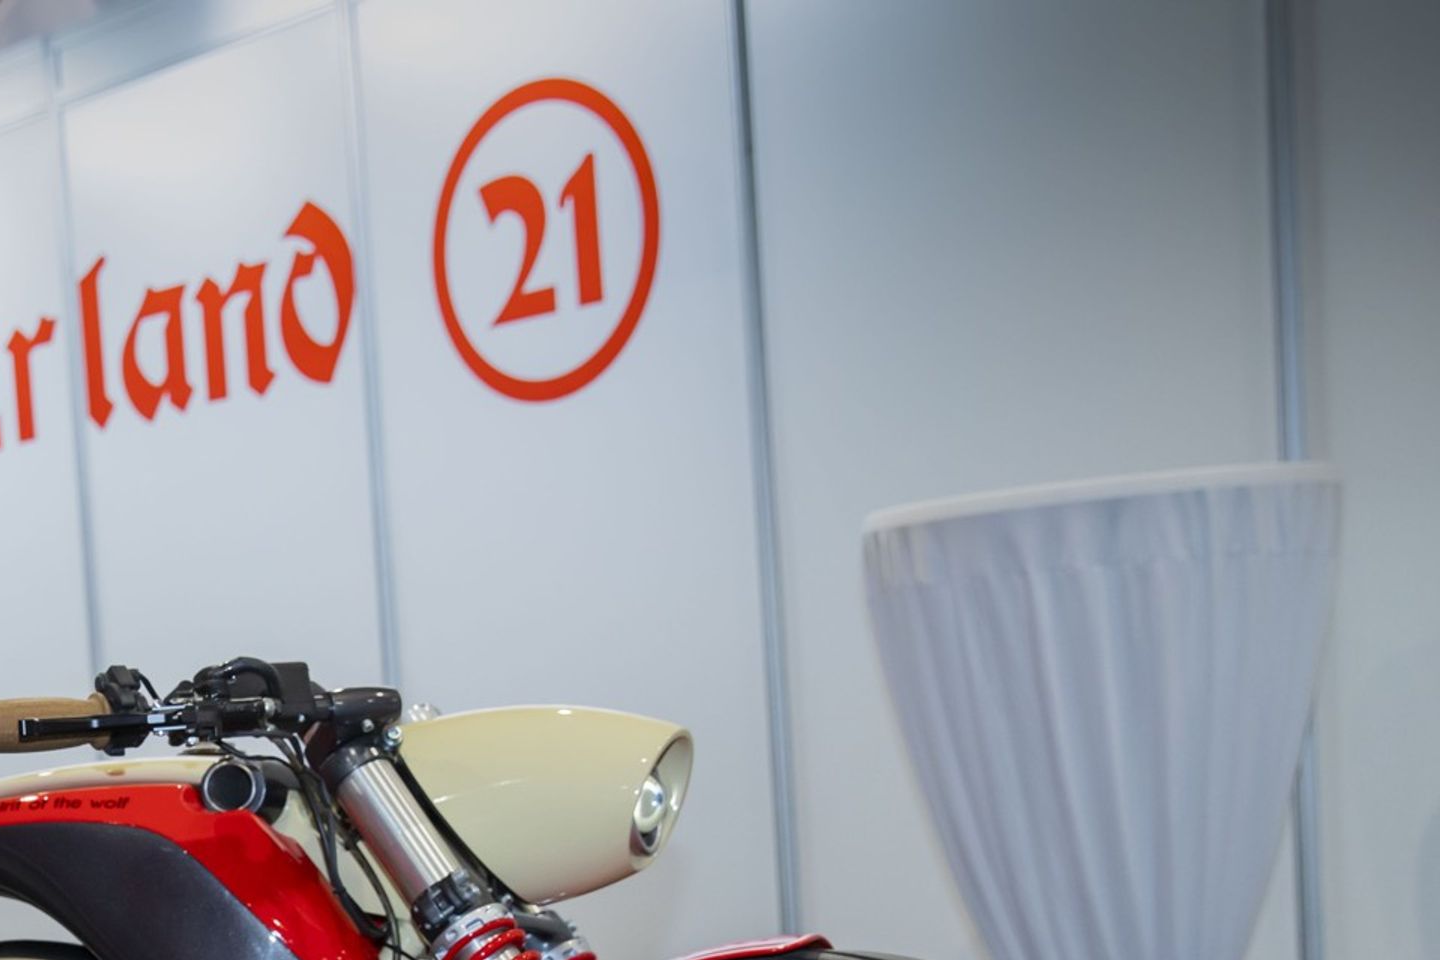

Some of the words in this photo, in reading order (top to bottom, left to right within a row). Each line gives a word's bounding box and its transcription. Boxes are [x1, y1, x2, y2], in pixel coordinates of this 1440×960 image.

[478, 152, 605, 327] 21
[53, 797, 81, 810] the
[90, 797, 129, 810] wolf
